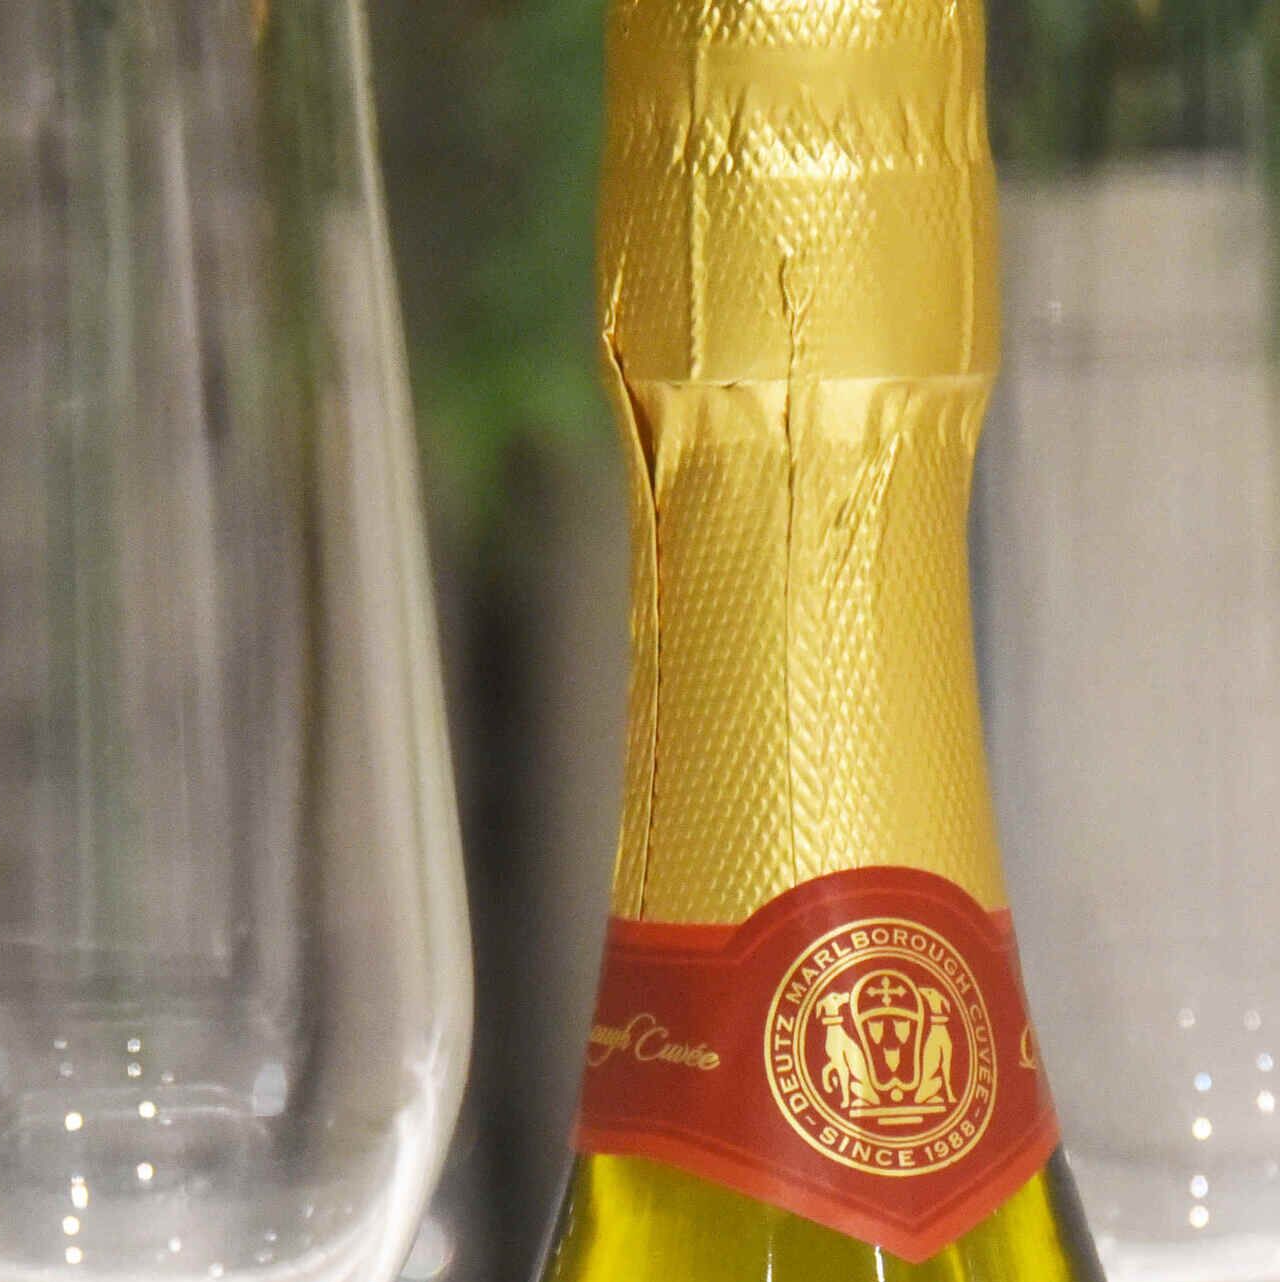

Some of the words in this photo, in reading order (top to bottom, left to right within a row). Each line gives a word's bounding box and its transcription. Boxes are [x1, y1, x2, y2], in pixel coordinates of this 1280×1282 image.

[785, 928, 971, 1004] MARLBOROUGH
[775, 1015, 809, 1115] DEUTZ
[819, 1126, 917, 1168] SINCE
[924, 1119, 977, 1162] 1988
